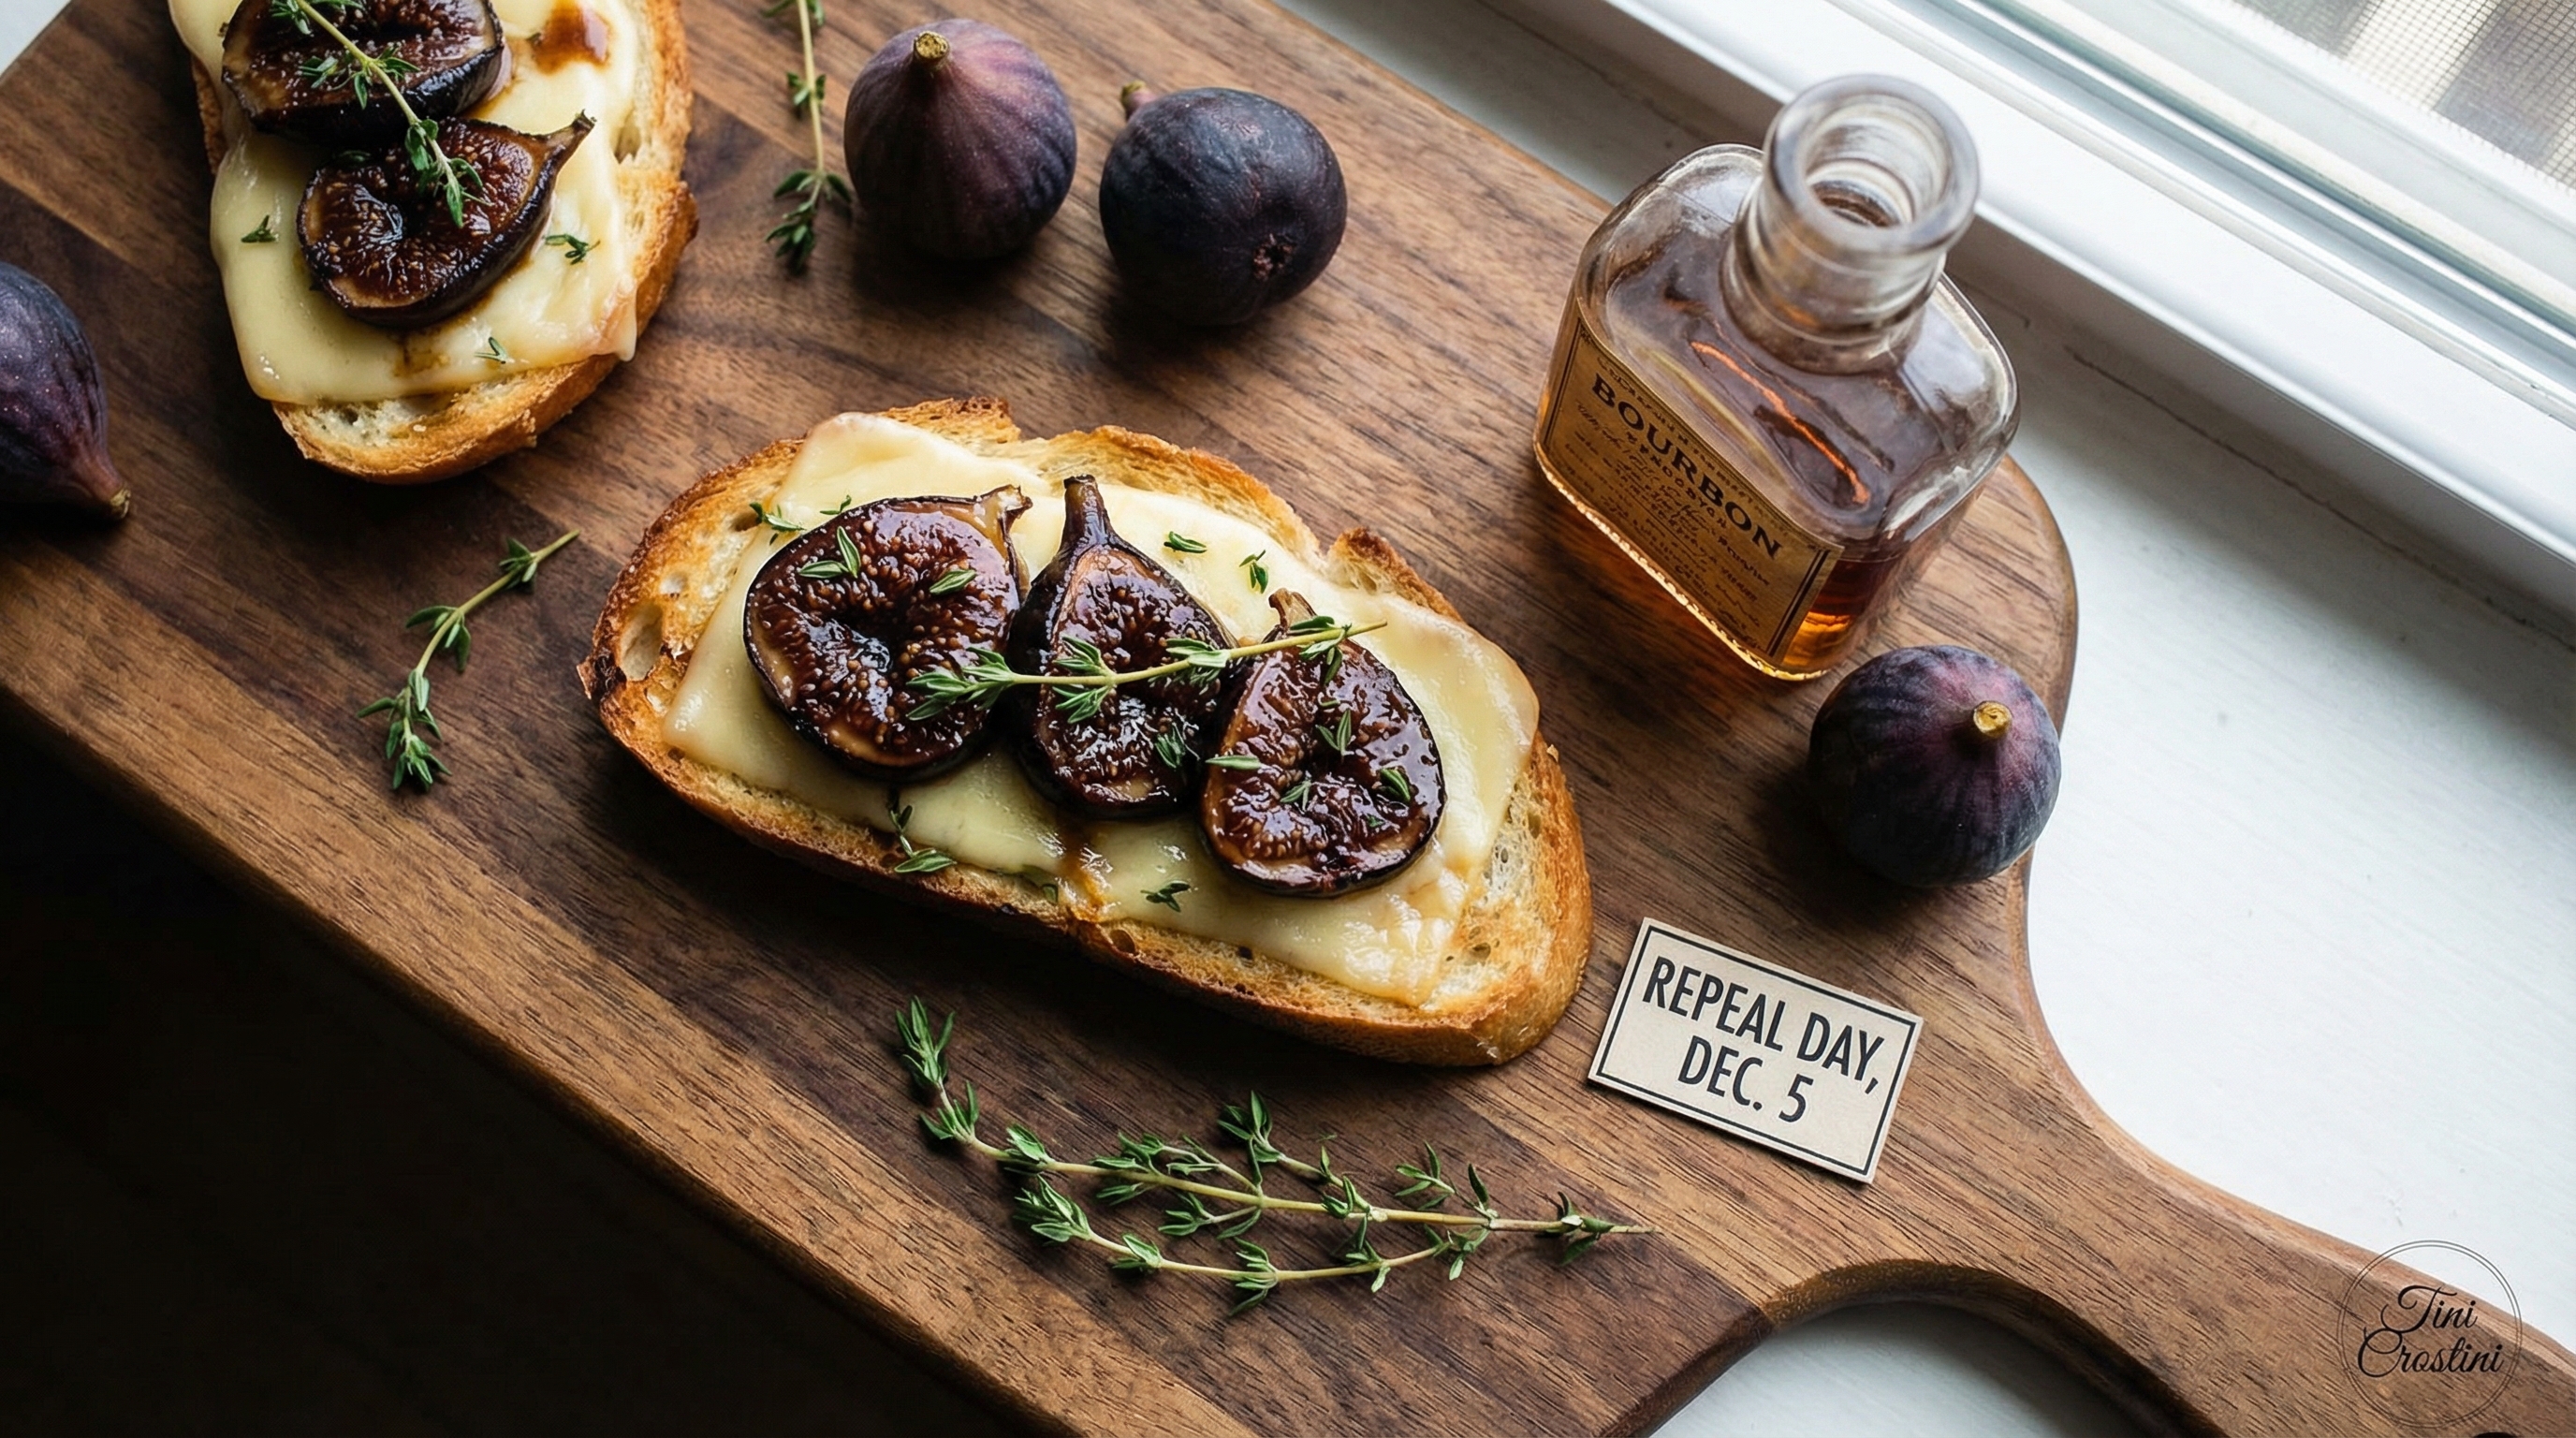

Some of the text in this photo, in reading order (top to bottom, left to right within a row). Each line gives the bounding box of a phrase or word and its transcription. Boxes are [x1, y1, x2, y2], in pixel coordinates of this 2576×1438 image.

[1591, 373, 1781, 558] BOURBON
[1643, 956, 1884, 1094] REPEAL DAY,
[1677, 1035, 1813, 1123] DEC. 5
